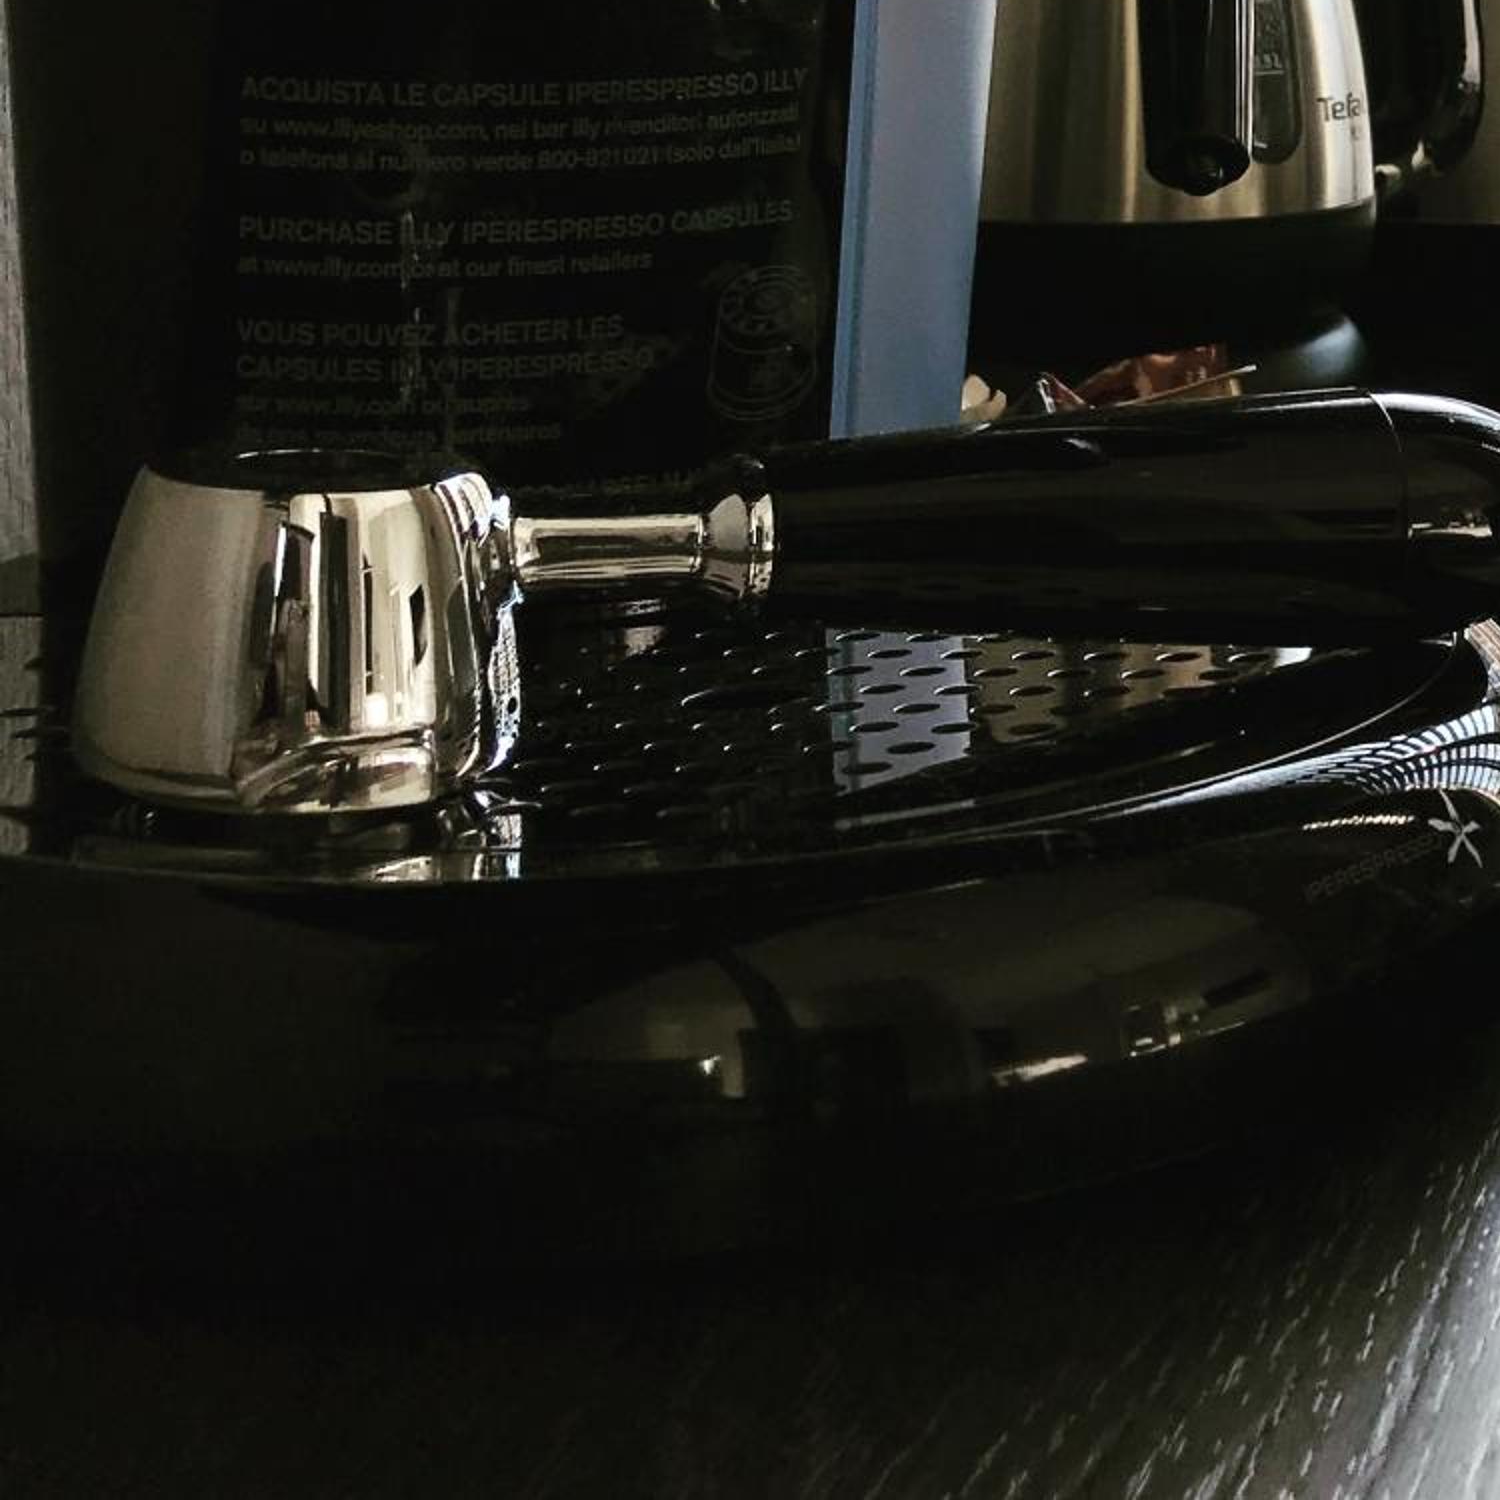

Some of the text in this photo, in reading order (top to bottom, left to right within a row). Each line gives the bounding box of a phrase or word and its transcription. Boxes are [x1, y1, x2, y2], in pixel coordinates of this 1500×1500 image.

[240, 67, 809, 108] ACQUISTA LE CAPSULE IPERESPRESSO ILLY
[239, 214, 394, 245] PURCHASE
[462, 211, 664, 245] IPERESPRESSO
[671, 199, 794, 235] CAPSULES
[235, 319, 317, 346] VOUS
[443, 317, 569, 346] ACHETER
[575, 312, 625, 341] LES
[235, 355, 383, 383] CAPSULES
